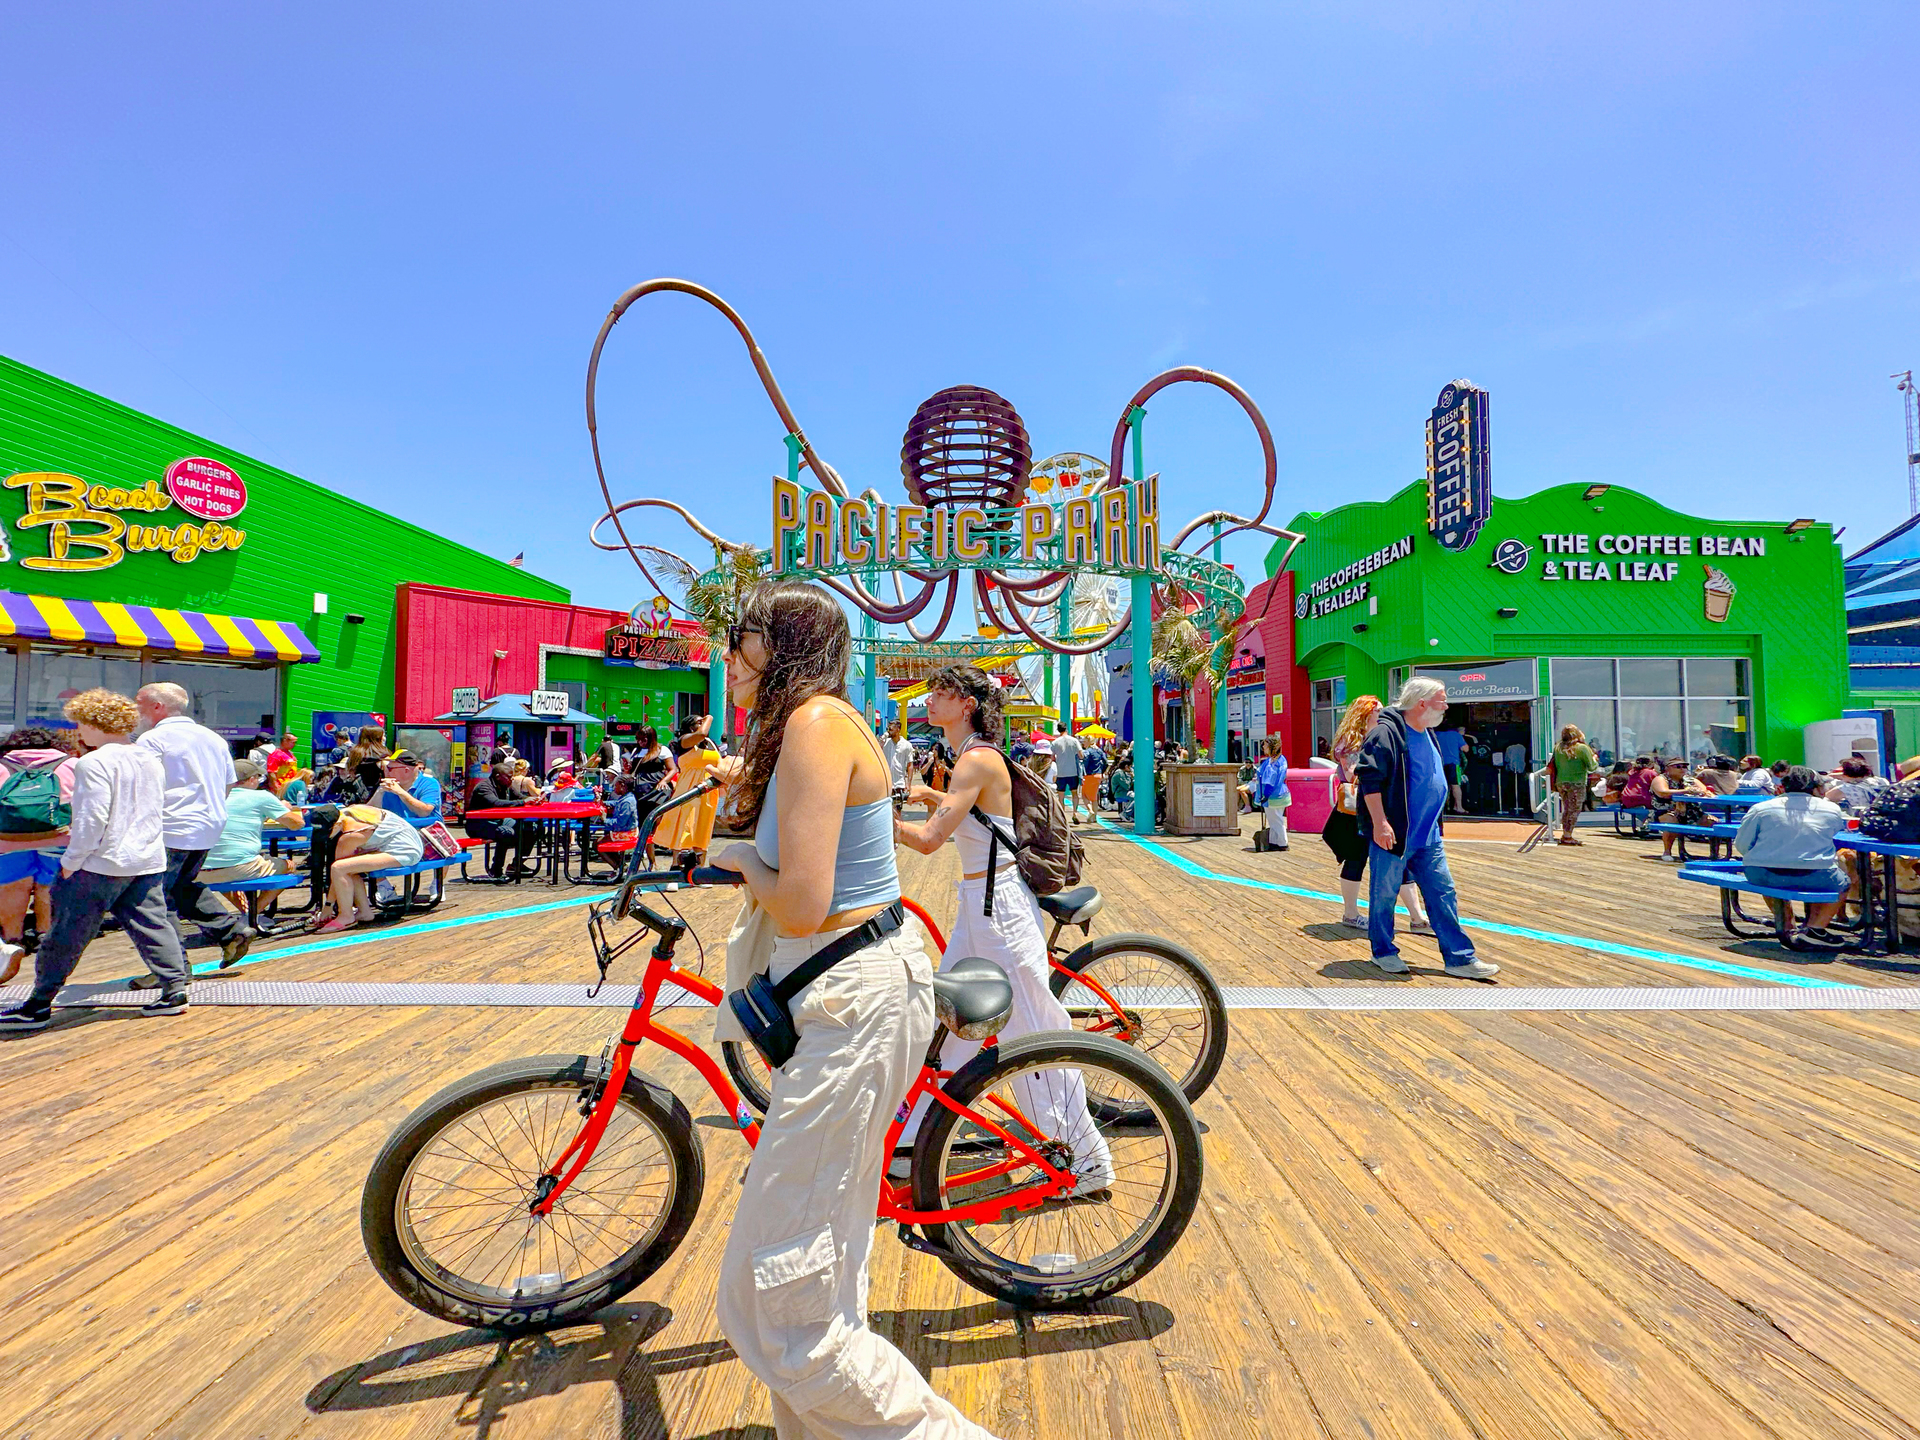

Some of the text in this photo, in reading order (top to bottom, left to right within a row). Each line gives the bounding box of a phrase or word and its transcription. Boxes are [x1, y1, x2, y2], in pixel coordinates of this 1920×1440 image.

[1437, 406, 1459, 429] FRESH
[187, 461, 232, 481] BURGERS
[1437, 420, 1461, 531] COFFEE
[3, 471, 173, 522] Beach
[176, 475, 241, 500] GARLIC FRIES
[184, 494, 232, 514] HOT DOGS
[772, 472, 1162, 574] PACIFIC PARK
[17, 509, 247, 571] Burger
[1541, 534, 1765, 556] THE COFFEE BEAN
[1543, 560, 1679, 581] & TEA LEAF
[624, 624, 682, 638] PACIFIC WHEEL
[611, 634, 692, 662] PIZZA
[1459, 673, 1486, 683] OPEN
[455, 692, 476, 709] PHOTOS
[1446, 684, 1522, 697] Coffee Bean
[535, 694, 565, 712] PHOTOS
